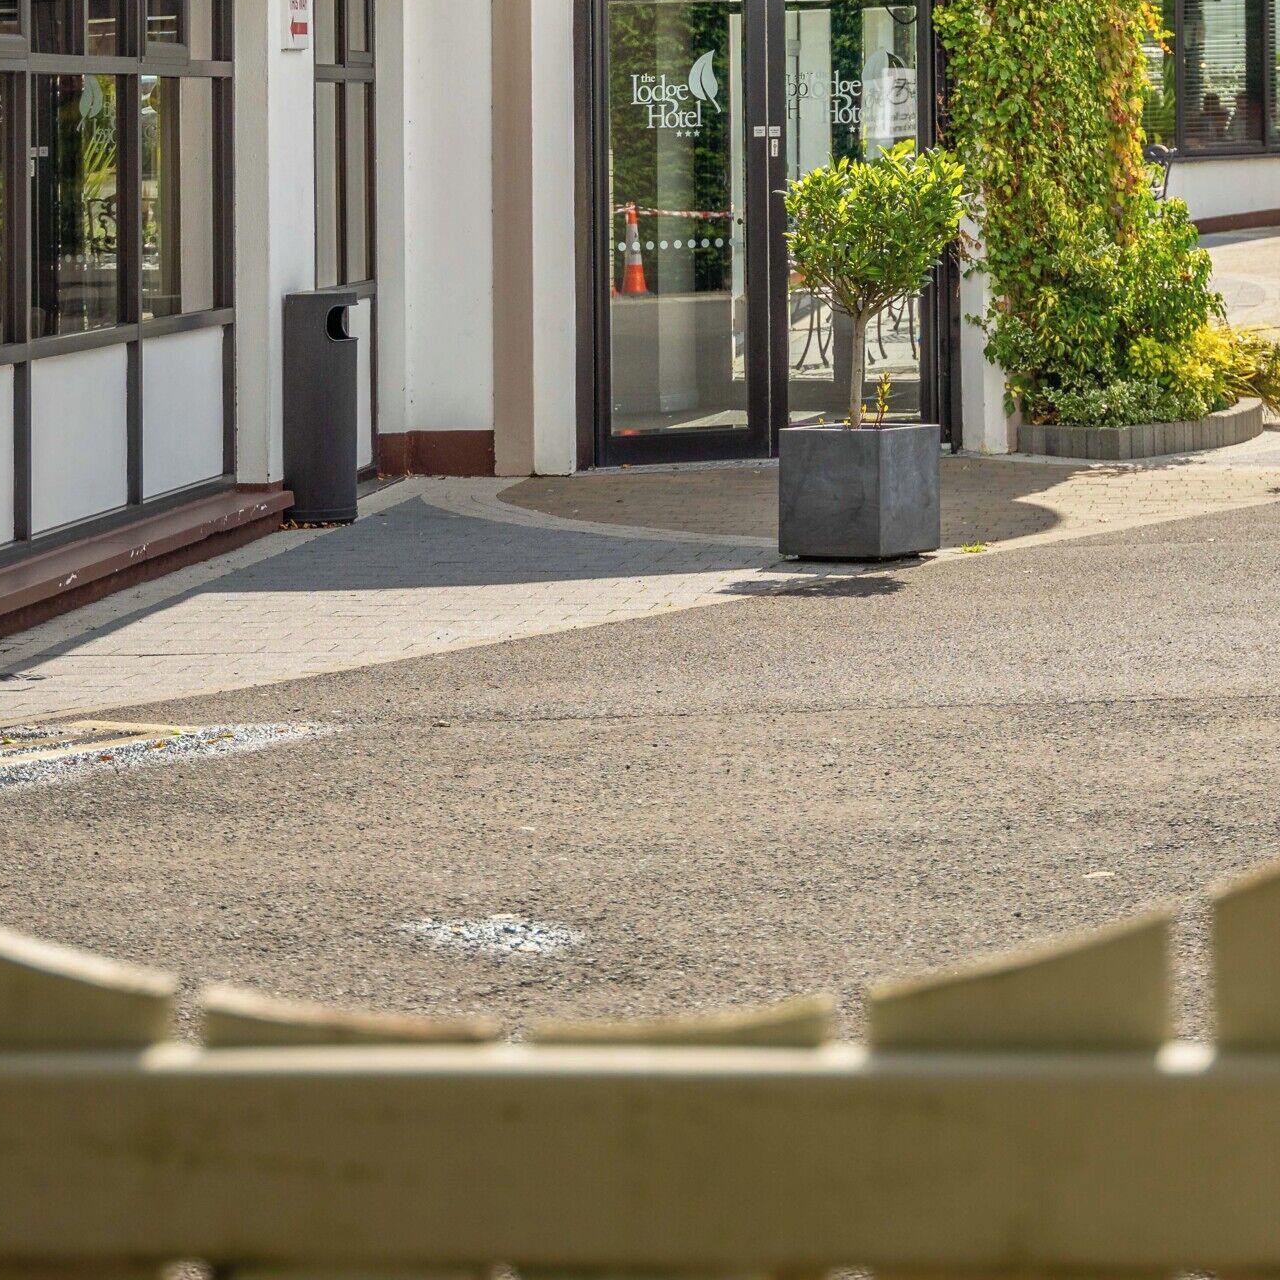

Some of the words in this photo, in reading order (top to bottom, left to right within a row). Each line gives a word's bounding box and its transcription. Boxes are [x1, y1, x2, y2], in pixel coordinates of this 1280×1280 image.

[630, 74, 689, 109] Lodge
[641, 73, 656, 83] the
[646, 100, 703, 129] Hotel
